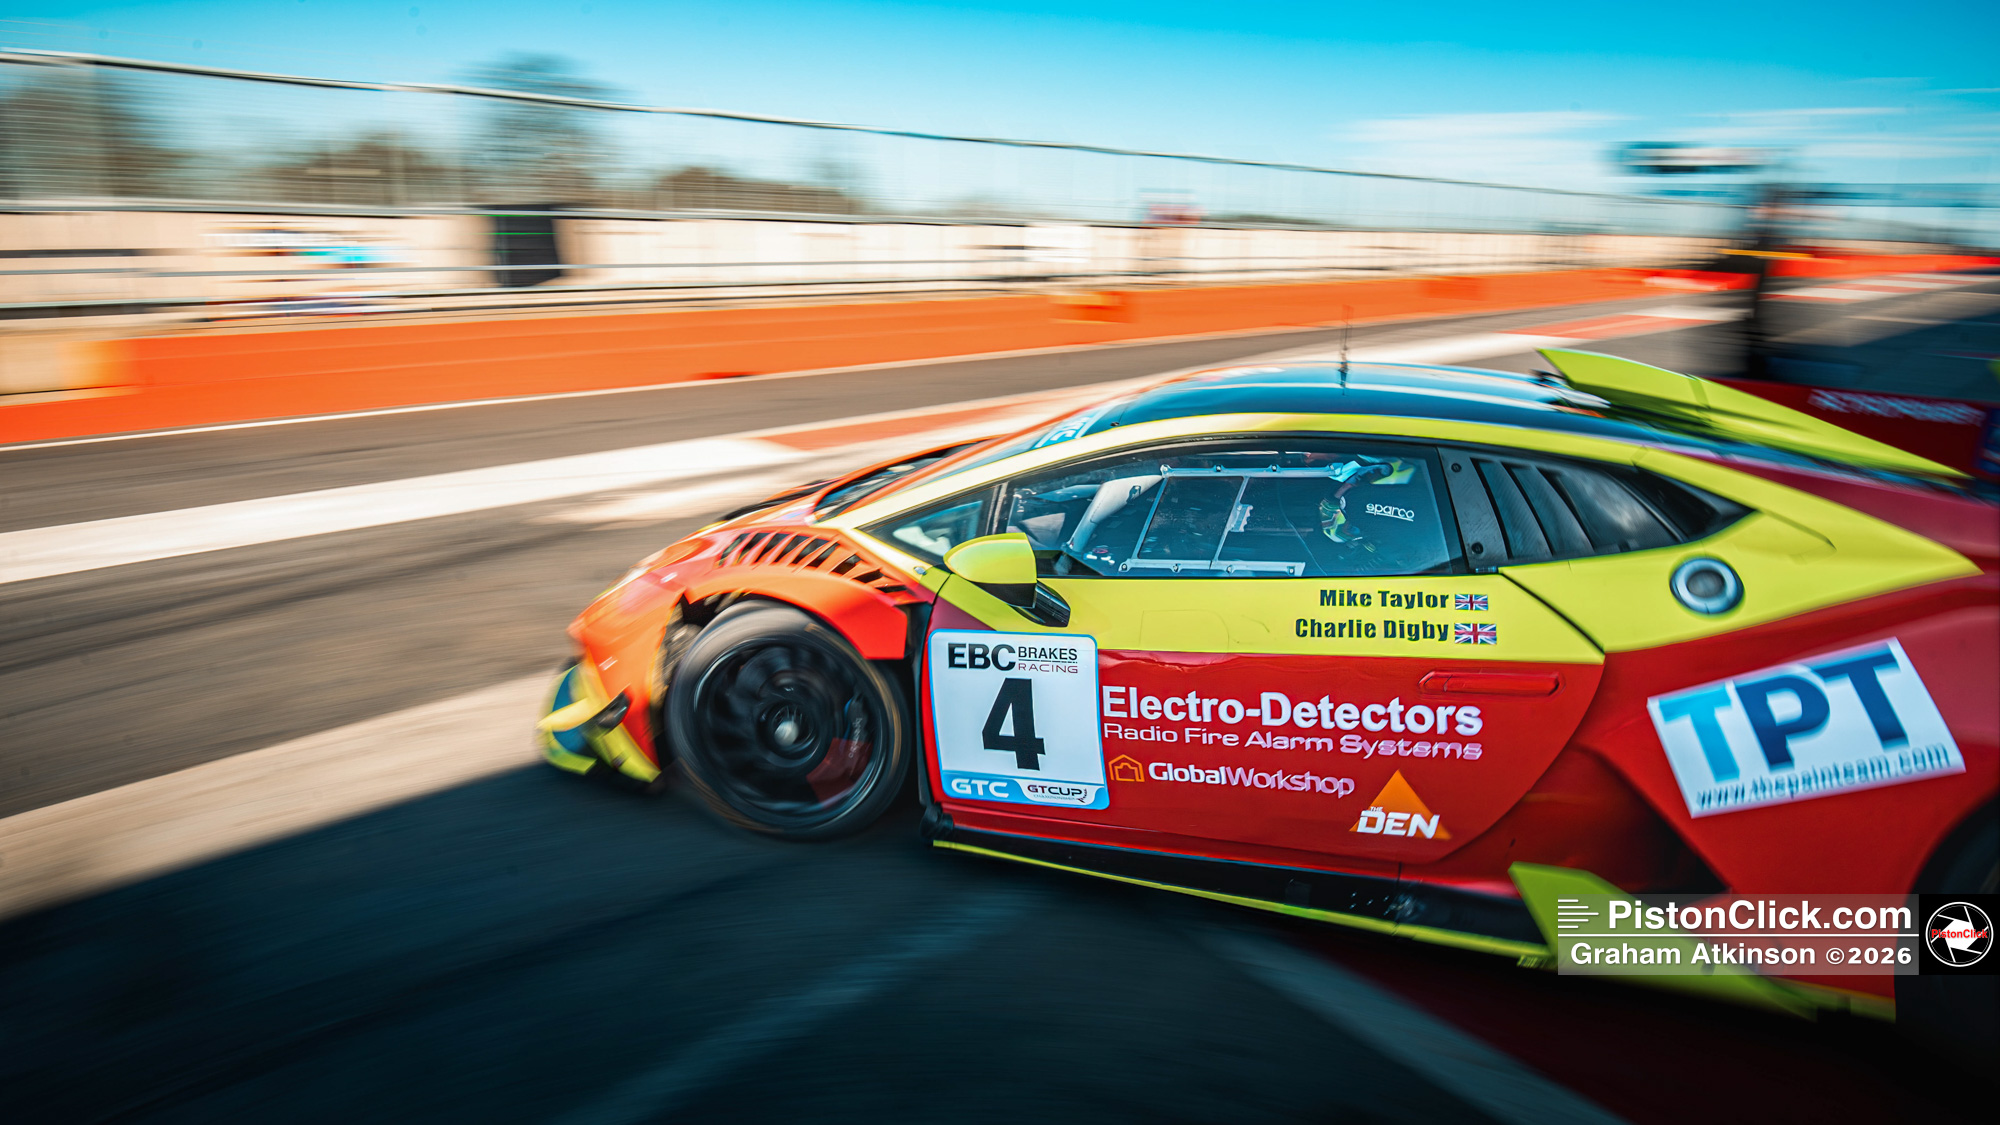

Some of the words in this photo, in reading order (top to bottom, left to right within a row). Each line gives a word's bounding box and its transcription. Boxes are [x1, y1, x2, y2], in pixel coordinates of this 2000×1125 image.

[1366, 503, 1415, 520] sparco
[1320, 589, 1372, 607] Mike
[1377, 590, 1450, 609] Taylor
[1295, 618, 1377, 638] Charlie
[1383, 620, 1449, 642] Digby
[947, 642, 1017, 672] EBC
[1018, 646, 1078, 661] BRAKES
[1018, 662, 1079, 674] RACING
[982, 677, 1046, 771] 4
[1102, 686, 1483, 736] Electro-Detectors
[1658, 648, 1911, 784] TPT
[1103, 723, 1178, 743] Radio
[1184, 727, 1239, 747] Fire
[1244, 731, 1334, 753] Alarm
[1339, 734, 1483, 760] Systems
[951, 778, 1010, 798] GTC
[1149, 762, 1355, 799] GlobalWorkshop
[1357, 810, 1440, 839] DEN
